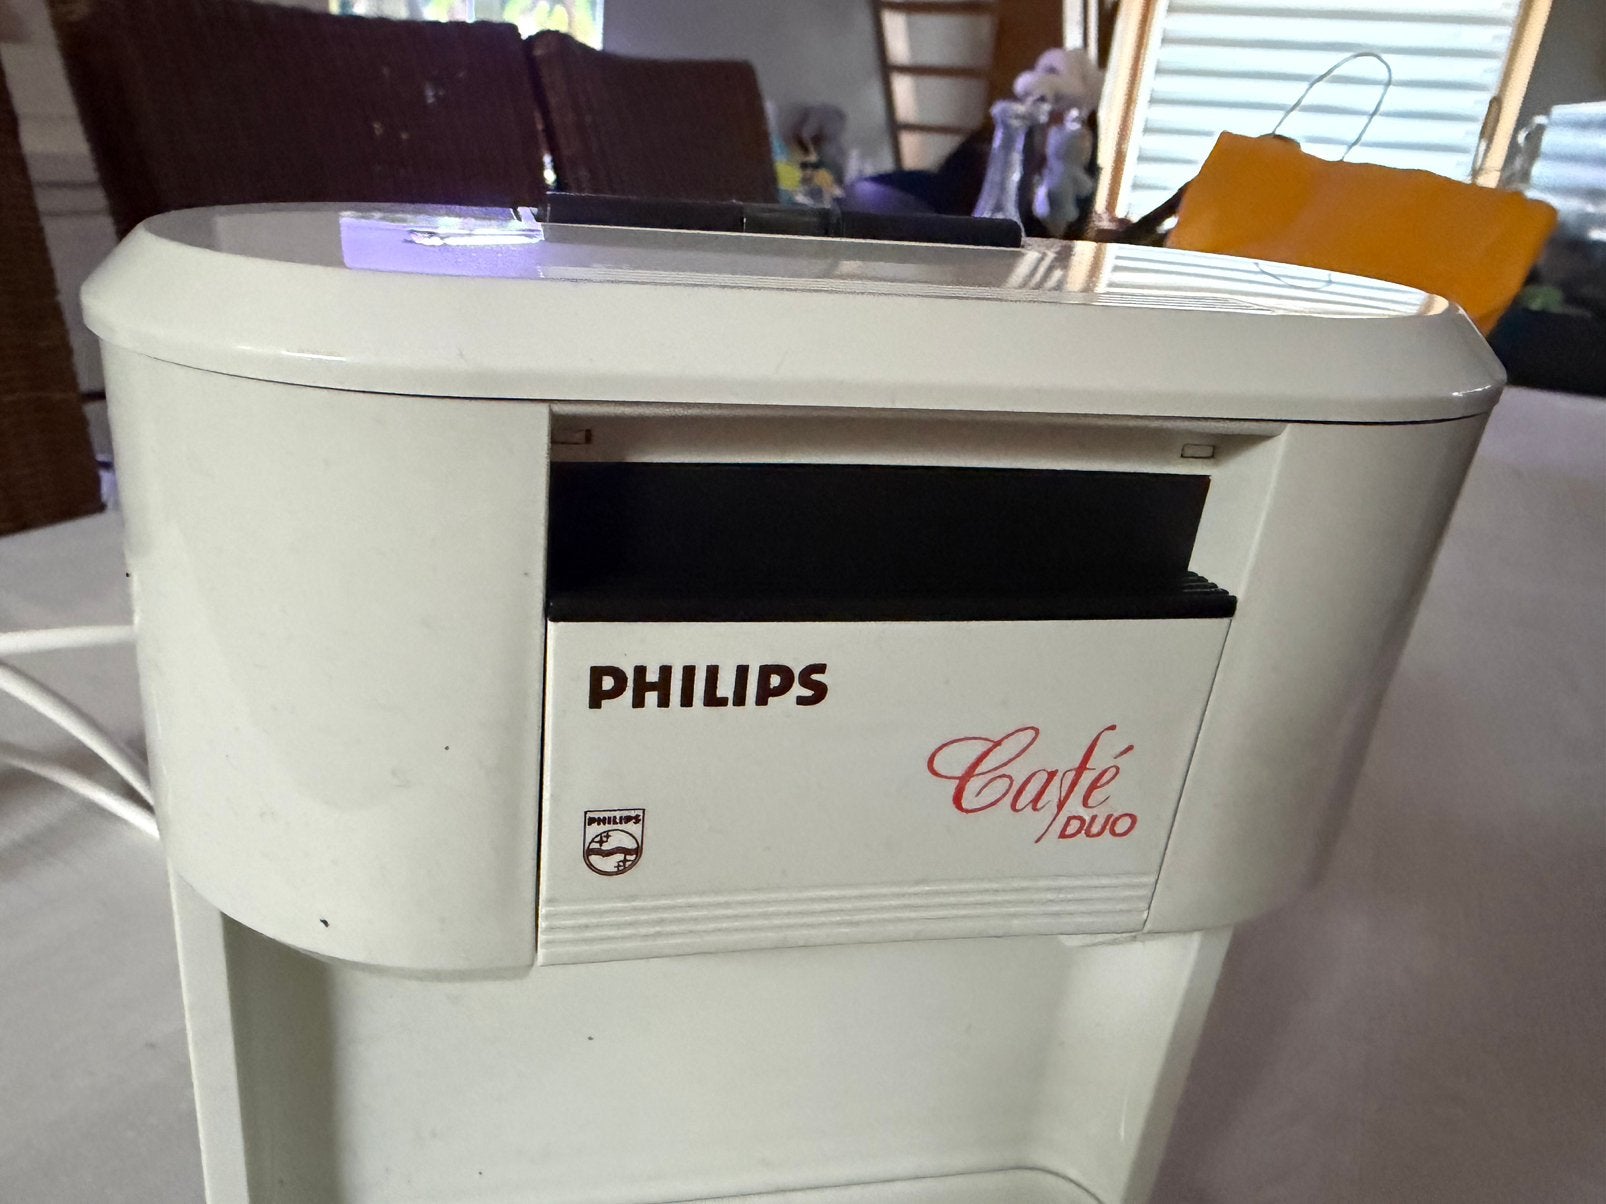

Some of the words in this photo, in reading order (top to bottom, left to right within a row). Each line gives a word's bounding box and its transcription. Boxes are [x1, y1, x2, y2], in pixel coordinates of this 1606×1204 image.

[588, 663, 829, 709] PHILIPS
[927, 724, 1135, 843] Café
[587, 814, 642, 826] PHILIPS
[1058, 813, 1138, 839] DUO
